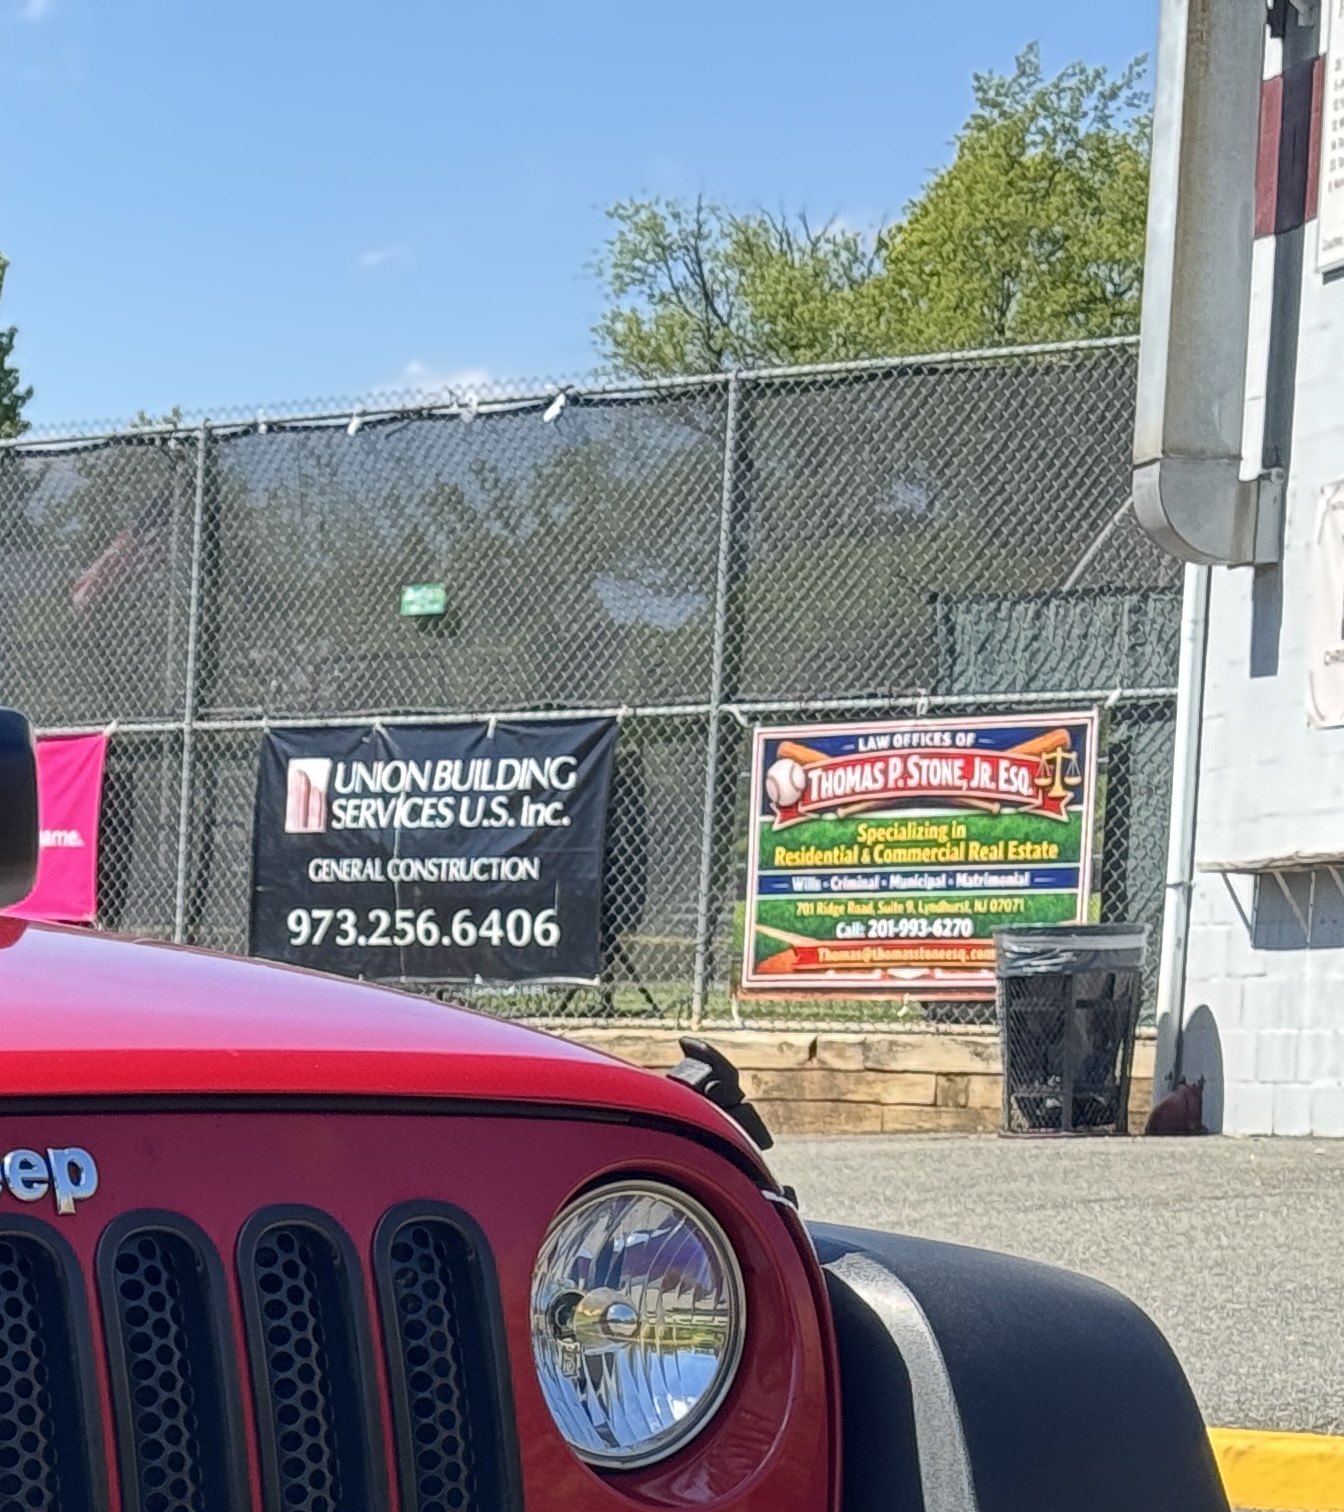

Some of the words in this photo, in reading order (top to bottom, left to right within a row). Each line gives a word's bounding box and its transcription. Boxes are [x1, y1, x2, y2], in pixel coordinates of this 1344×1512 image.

[858, 734, 891, 752] LAW
[892, 731, 952, 748] OFFICES
[955, 731, 977, 747] OF
[334, 759, 433, 794] UNION
[432, 756, 578, 791] BUILDING
[808, 761, 886, 801] THOMAS
[888, 757, 905, 788] P.
[906, 755, 968, 790] STONE,
[970, 757, 996, 788] JR.
[999, 760, 1034, 795] ESQ.
[331, 795, 455, 829] SERVICES
[459, 795, 515, 828] U.S.
[520, 795, 571, 827] Inc.
[857, 821, 947, 845] Specializing
[951, 821, 966, 840] in
[774, 844, 859, 867] Residential
[861, 850, 870, 864] &
[873, 842, 965, 864] Commercial
[968, 840, 1004, 862] Real
[1008, 840, 1059, 861] Estate
[308, 858, 385, 882] GENERAL
[386, 857, 540, 881] CONSTRUCTION
[791, 876, 822, 891] Wills
[830, 874, 880, 890] Criminal
[889, 872, 946, 891] Municipal
[956, 871, 1030, 888] Matrimonial
[816, 900, 845, 917] Ridge
[877, 900, 904, 914] Suite
[287, 908, 561, 947] 973.256.6406
[836, 921, 866, 939] Call:
[868, 917, 974, 939] 201-993-6270
